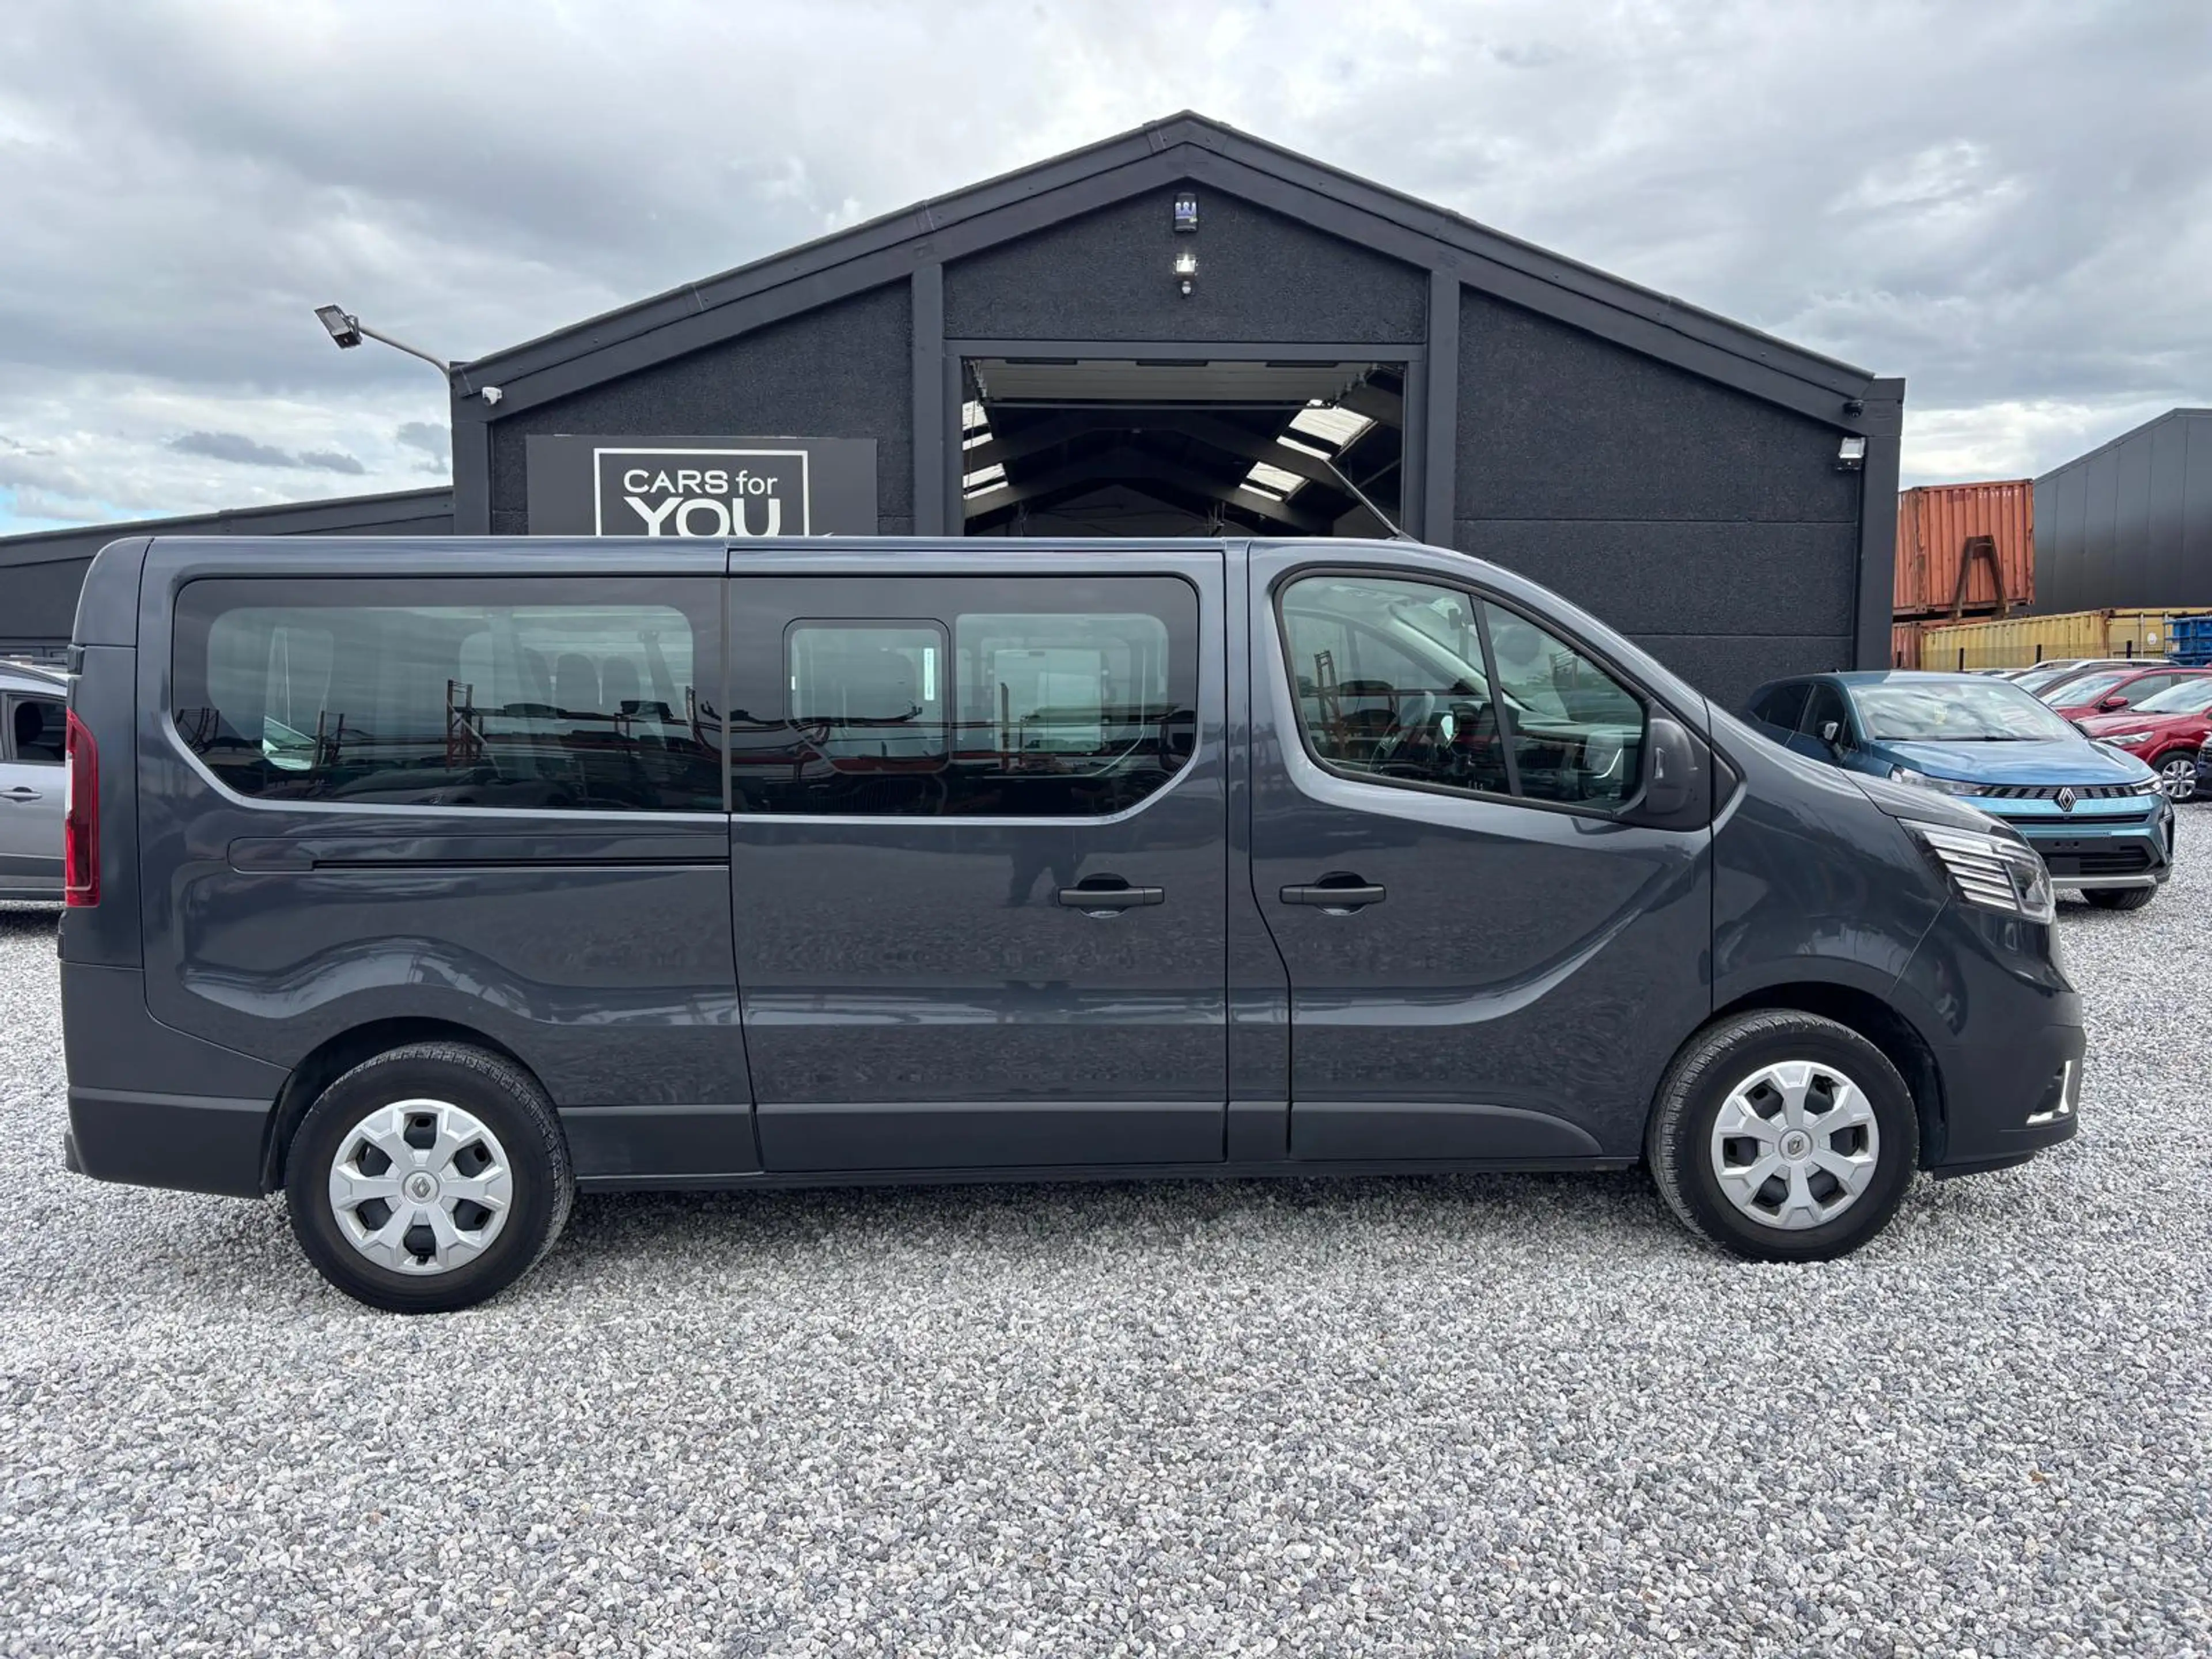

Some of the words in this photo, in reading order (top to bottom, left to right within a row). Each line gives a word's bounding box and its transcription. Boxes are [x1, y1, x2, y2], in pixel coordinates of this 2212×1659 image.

[623, 469, 729, 494] CARS
[736, 470, 778, 495] for
[623, 497, 781, 537] YOU
